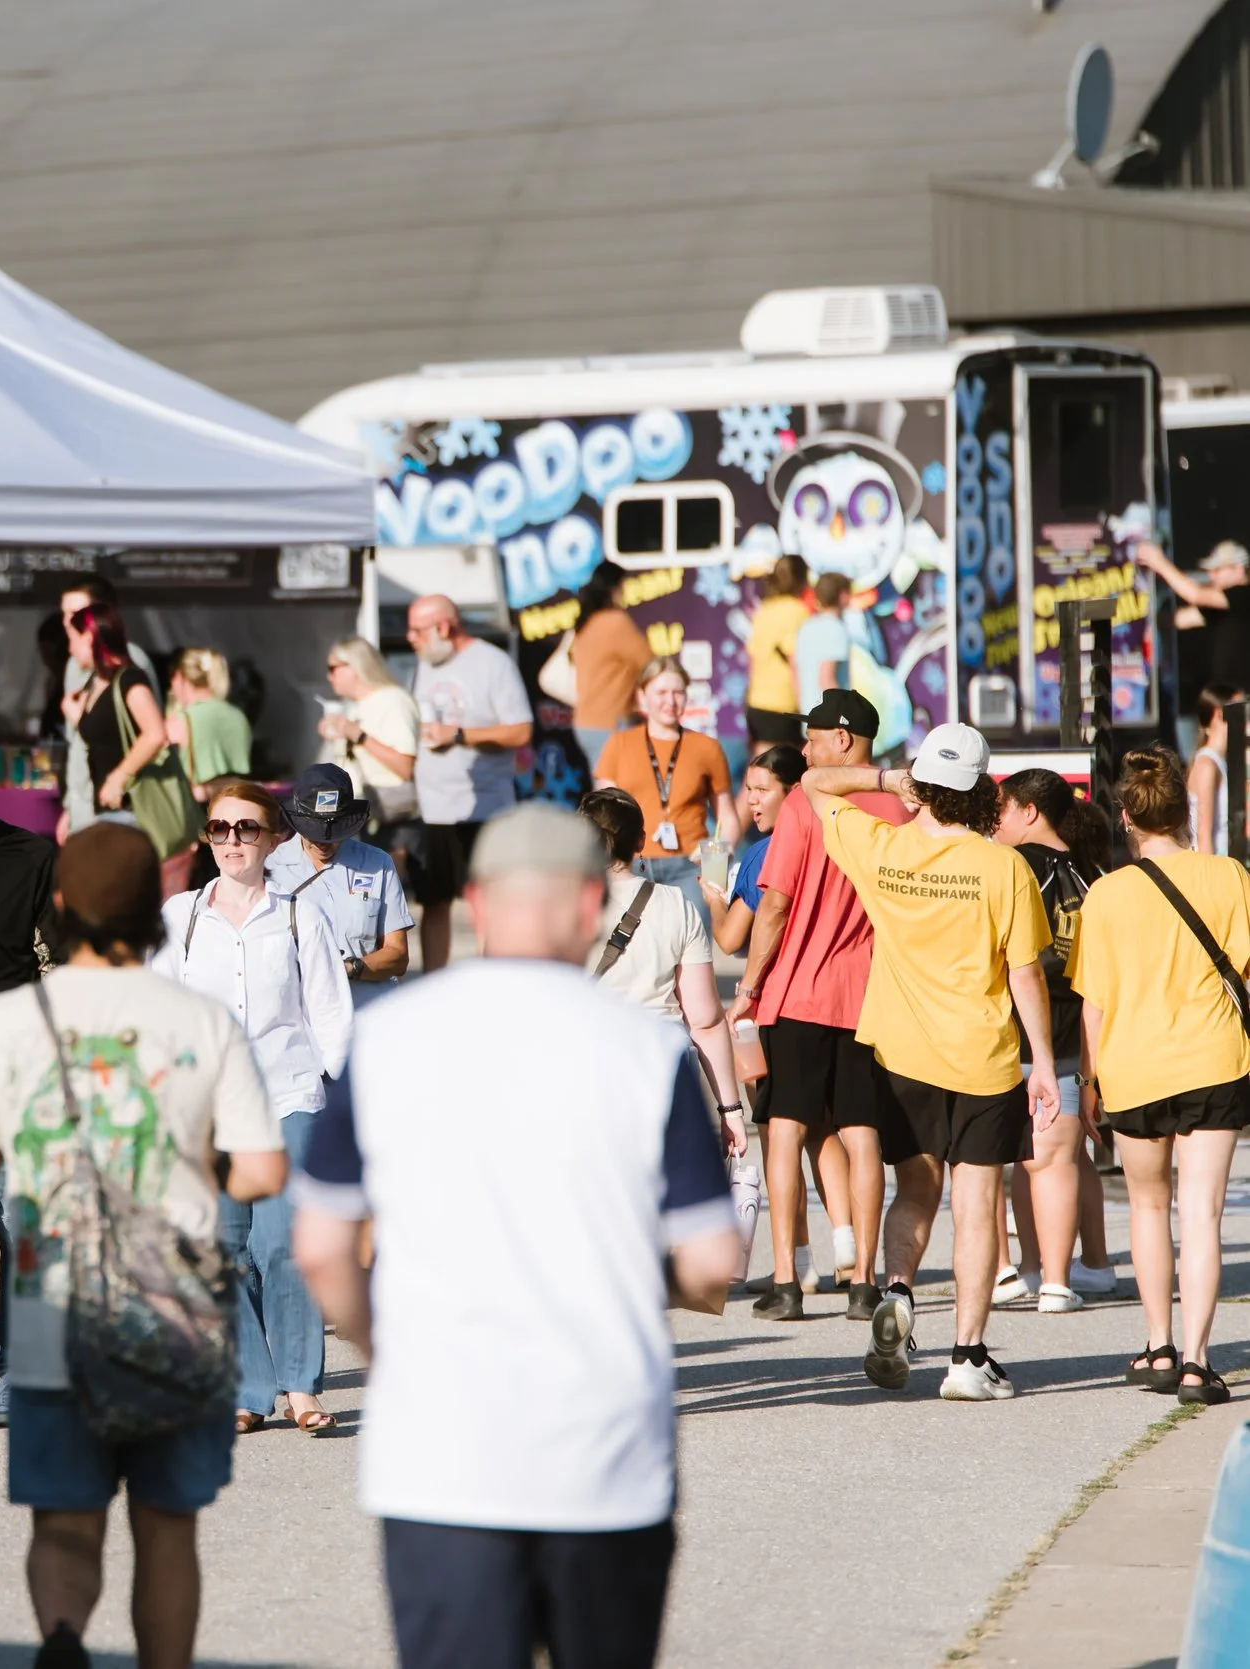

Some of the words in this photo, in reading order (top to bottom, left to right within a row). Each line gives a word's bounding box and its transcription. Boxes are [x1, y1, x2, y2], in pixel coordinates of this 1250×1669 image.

[878, 866, 916, 881] ROCK
[920, 873, 982, 886] SQUAWK
[877, 880, 982, 901] CHICKENHAWK
